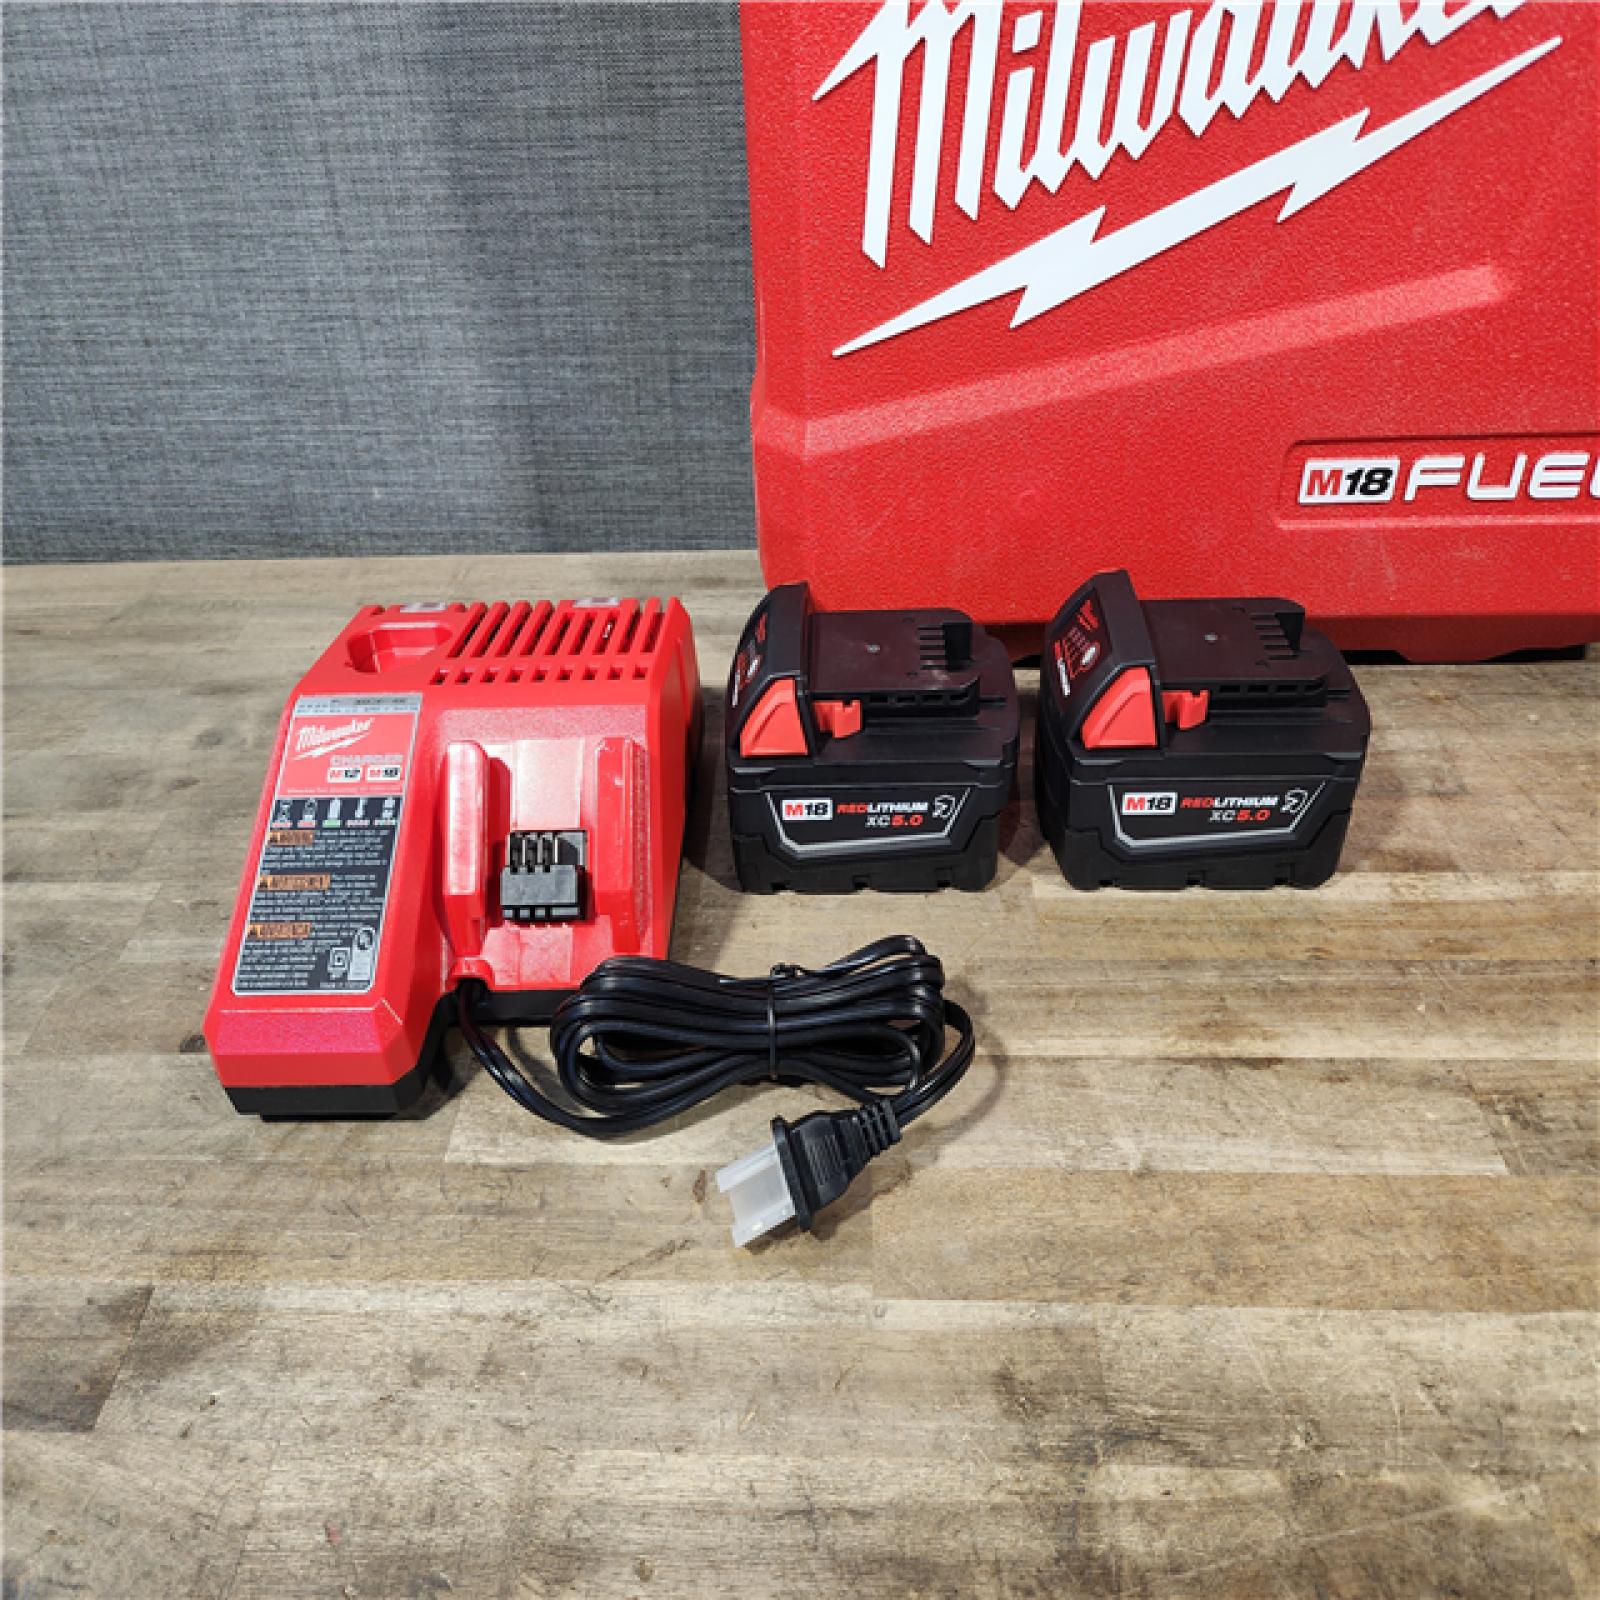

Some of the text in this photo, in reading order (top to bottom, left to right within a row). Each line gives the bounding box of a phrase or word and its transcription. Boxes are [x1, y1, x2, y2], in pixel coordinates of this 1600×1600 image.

[812, 0, 1526, 269] Milwau
[1305, 452, 1600, 502] M18 FUE
[783, 801, 829, 817] M18
[1124, 796, 1173, 812] M18
